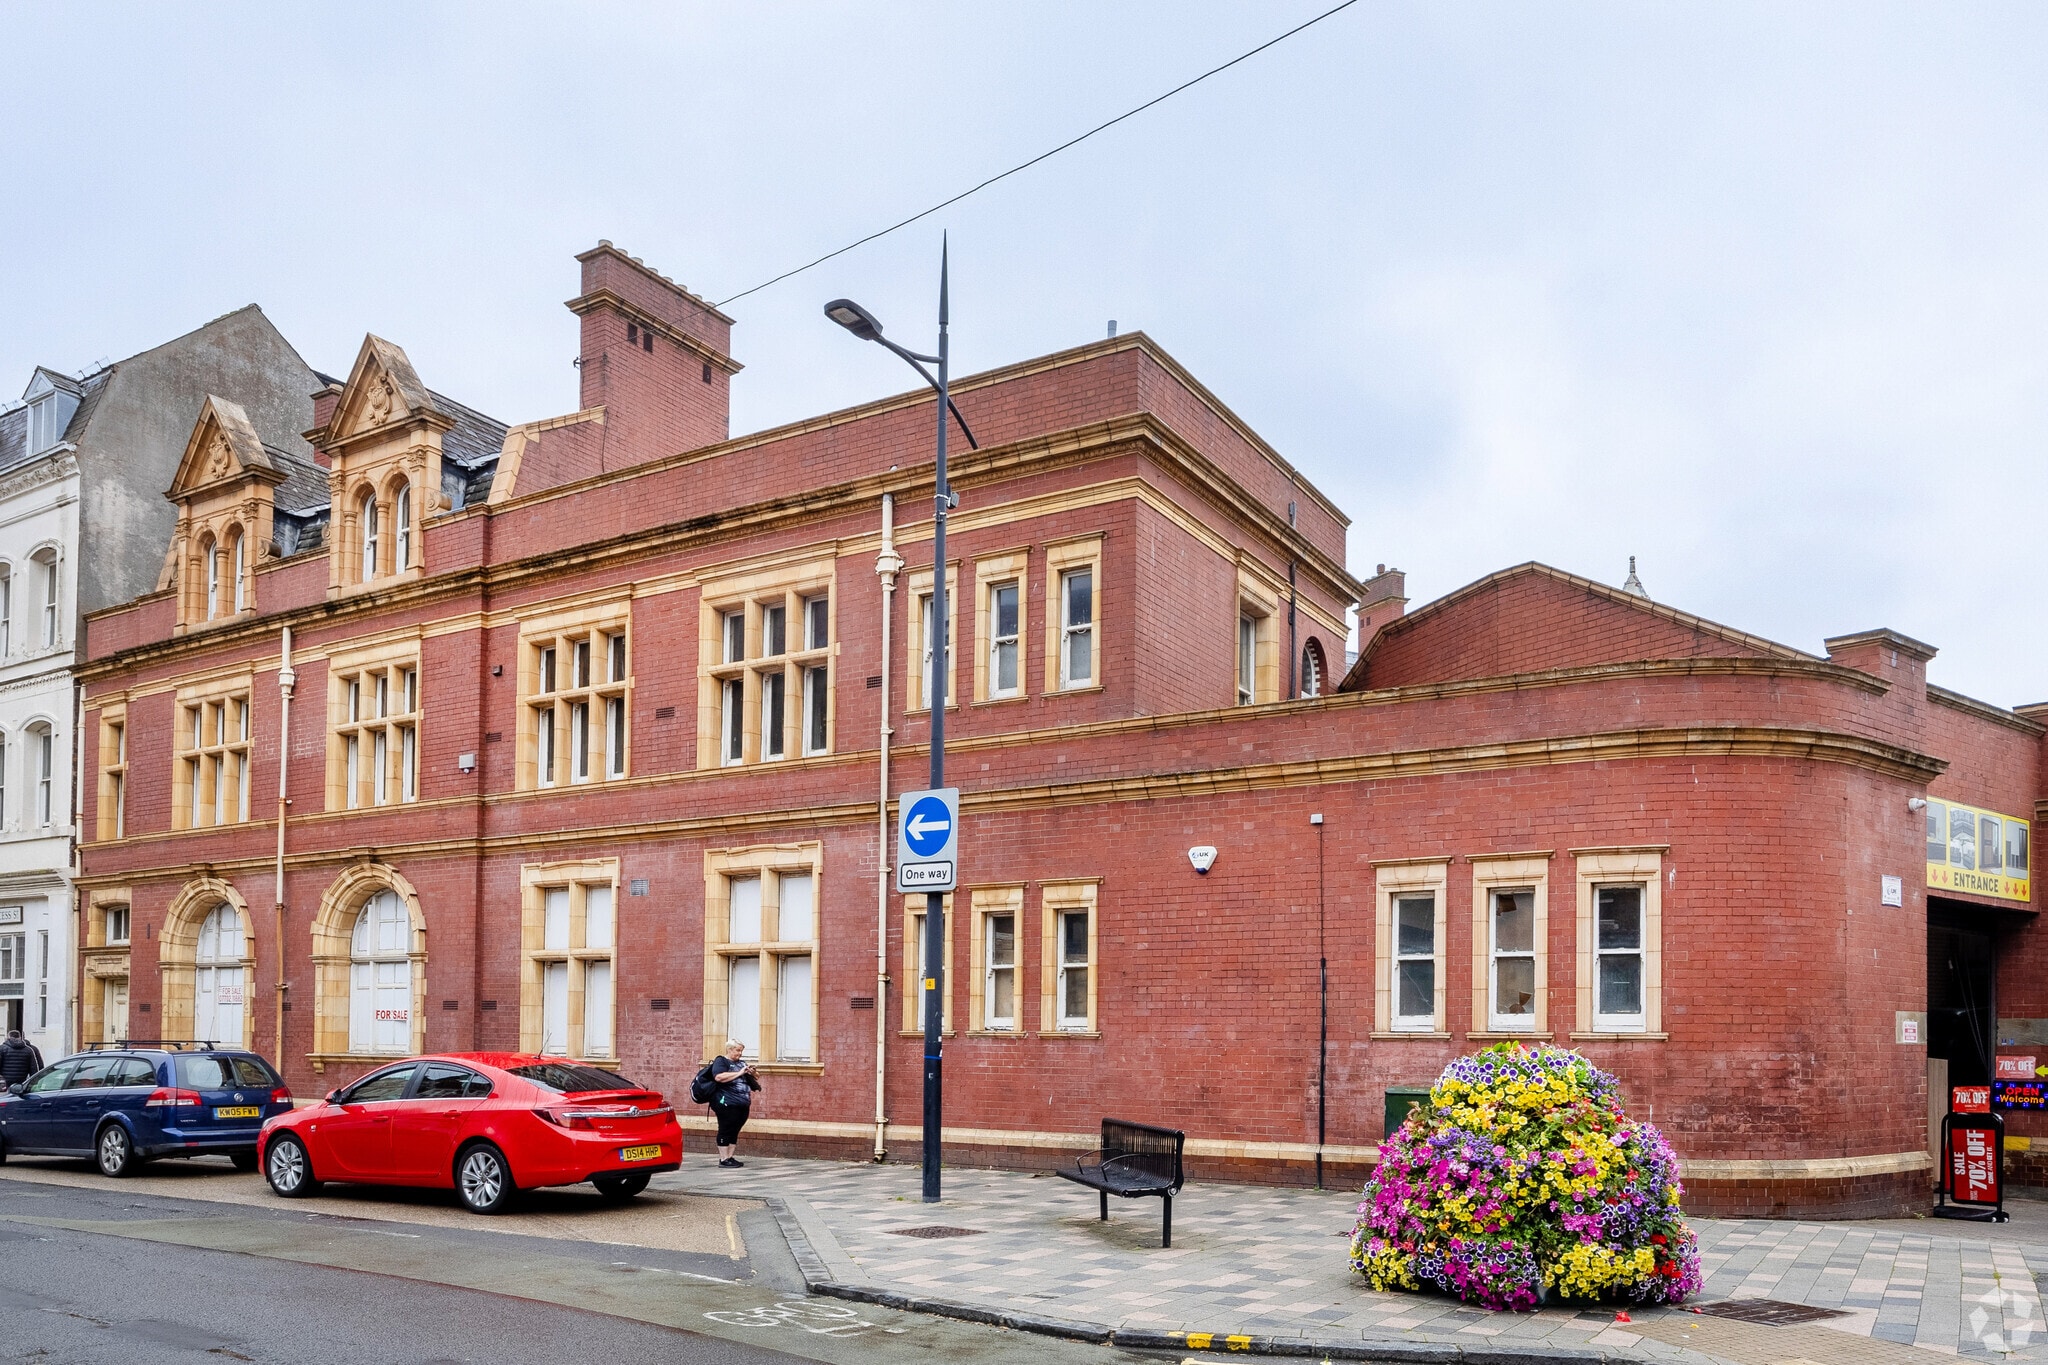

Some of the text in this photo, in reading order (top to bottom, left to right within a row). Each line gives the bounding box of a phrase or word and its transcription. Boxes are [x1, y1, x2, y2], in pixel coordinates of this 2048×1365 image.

[906, 869, 947, 880] One way
[1954, 872, 1999, 893] ENTRANCE
[376, 1010, 408, 1020] FOR SALE
[1999, 1060, 2034, 1072] 70% OFF
[1955, 1091, 1988, 1104] 70% OFF
[2006, 1087, 2039, 1096] OPEN
[2000, 1094, 2045, 1104] Welcome
[1966, 1129, 1986, 1156] OFF
[625, 1148, 644, 1159] DS14
[1954, 1151, 1966, 1175] SALE
[1967, 1160, 1988, 1190] 70%
